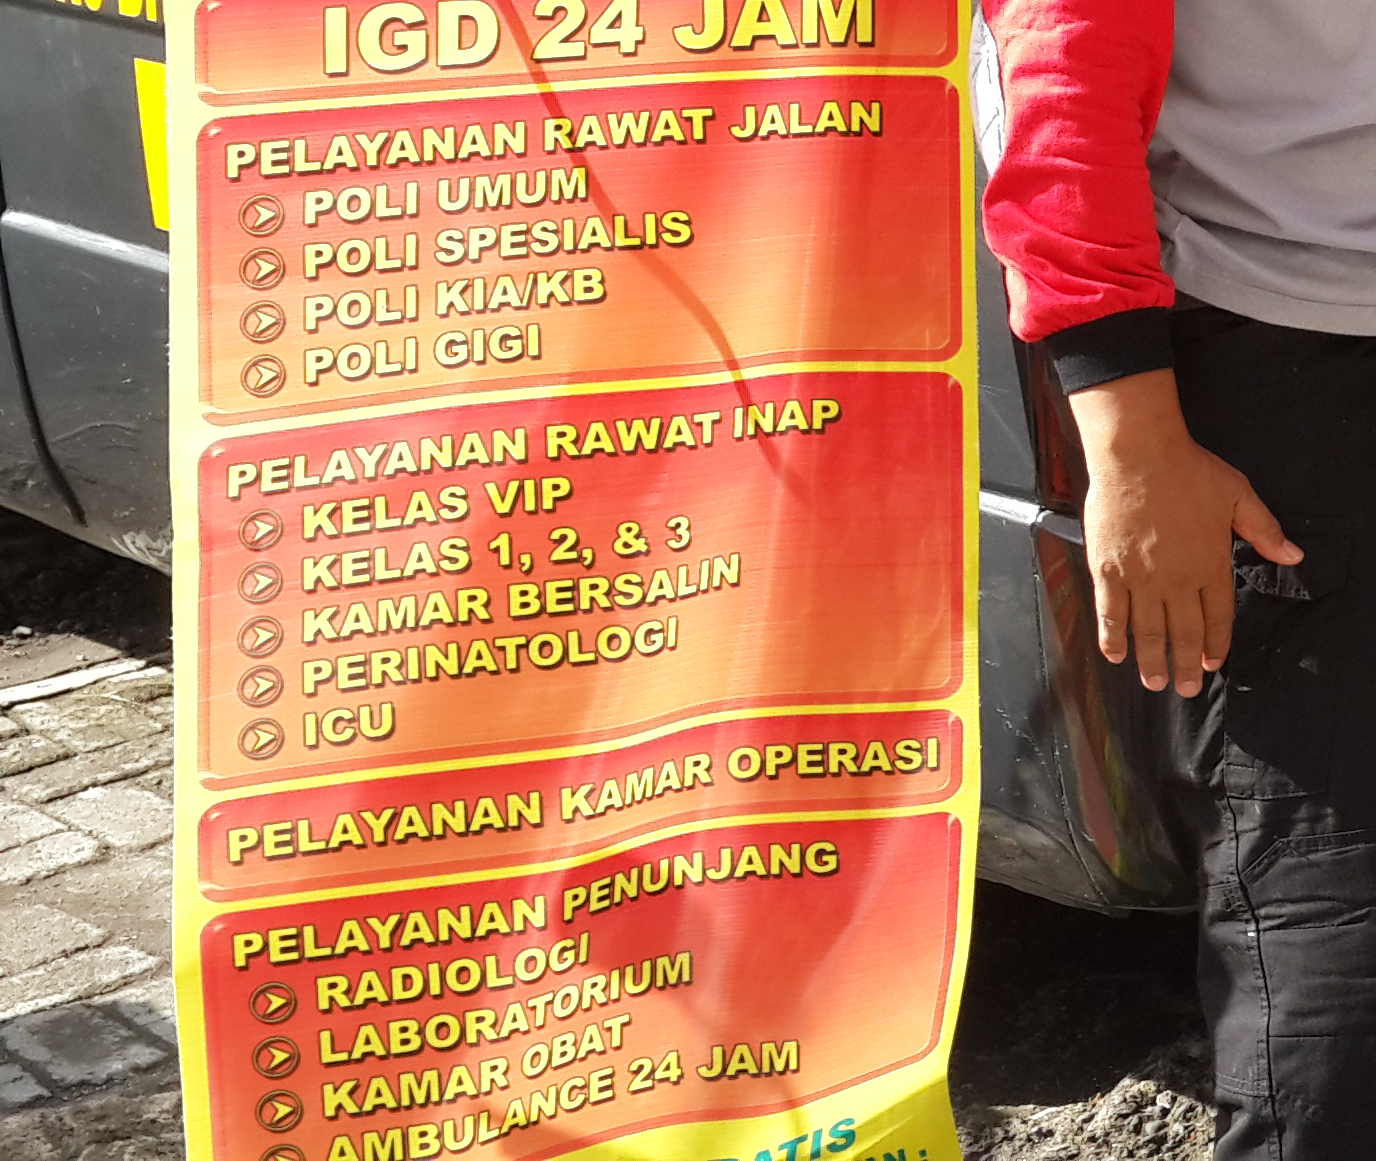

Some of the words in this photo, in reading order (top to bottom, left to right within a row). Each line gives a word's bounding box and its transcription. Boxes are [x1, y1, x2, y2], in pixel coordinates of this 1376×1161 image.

[323, 0, 500, 75] IGD
[226, 120, 526, 180] PELAYANAN
[544, 107, 713, 150] RAWAT
[729, 100, 882, 140] JALAN
[303, 182, 418, 227] POLI
[438, 167, 588, 212] UMUM
[303, 233, 418, 279] POLI
[436, 211, 693, 264] SPESIALIS
[303, 287, 418, 332] POLI
[436, 268, 605, 317] KIA/KB
[303, 339, 418, 385] POLI
[436, 324, 542, 367] GIGI
[226, 428, 528, 498] PELAYANAN
[547, 409, 722, 460] RAWAT
[732, 399, 843, 440] INAP
[302, 486, 470, 542] KELAS
[484, 476, 573, 515] VIP
[302, 537, 471, 592] KELAS
[488, 532, 533, 572] 1,
[549, 526, 595, 567] 2,
[613, 522, 651, 557] &
[665, 516, 691, 550] 3
[302, 587, 490, 643] KAMAR
[509, 554, 741, 617] BERSALIN
[302, 615, 679, 696] PERINATOLOGI
[303, 703, 396, 747] ICU
[226, 790, 542, 864] PELAYANAN
[560, 751, 713, 823] KAMAR
[726, 737, 940, 782] OPERASI
[232, 896, 547, 969] PELAYANAN
[562, 841, 841, 923] PENUNJANG
[316, 932, 591, 1012] RADIOLOGI
[318, 951, 693, 1065] LABORATORIUM
[321, 1057, 510, 1119] KAMAR
[521, 1014, 632, 1078] OBAT
[327, 1067, 616, 1161] AMBULANCE
[628, 1057, 684, 1094] 24
[698, 1040, 799, 1078] JAM
